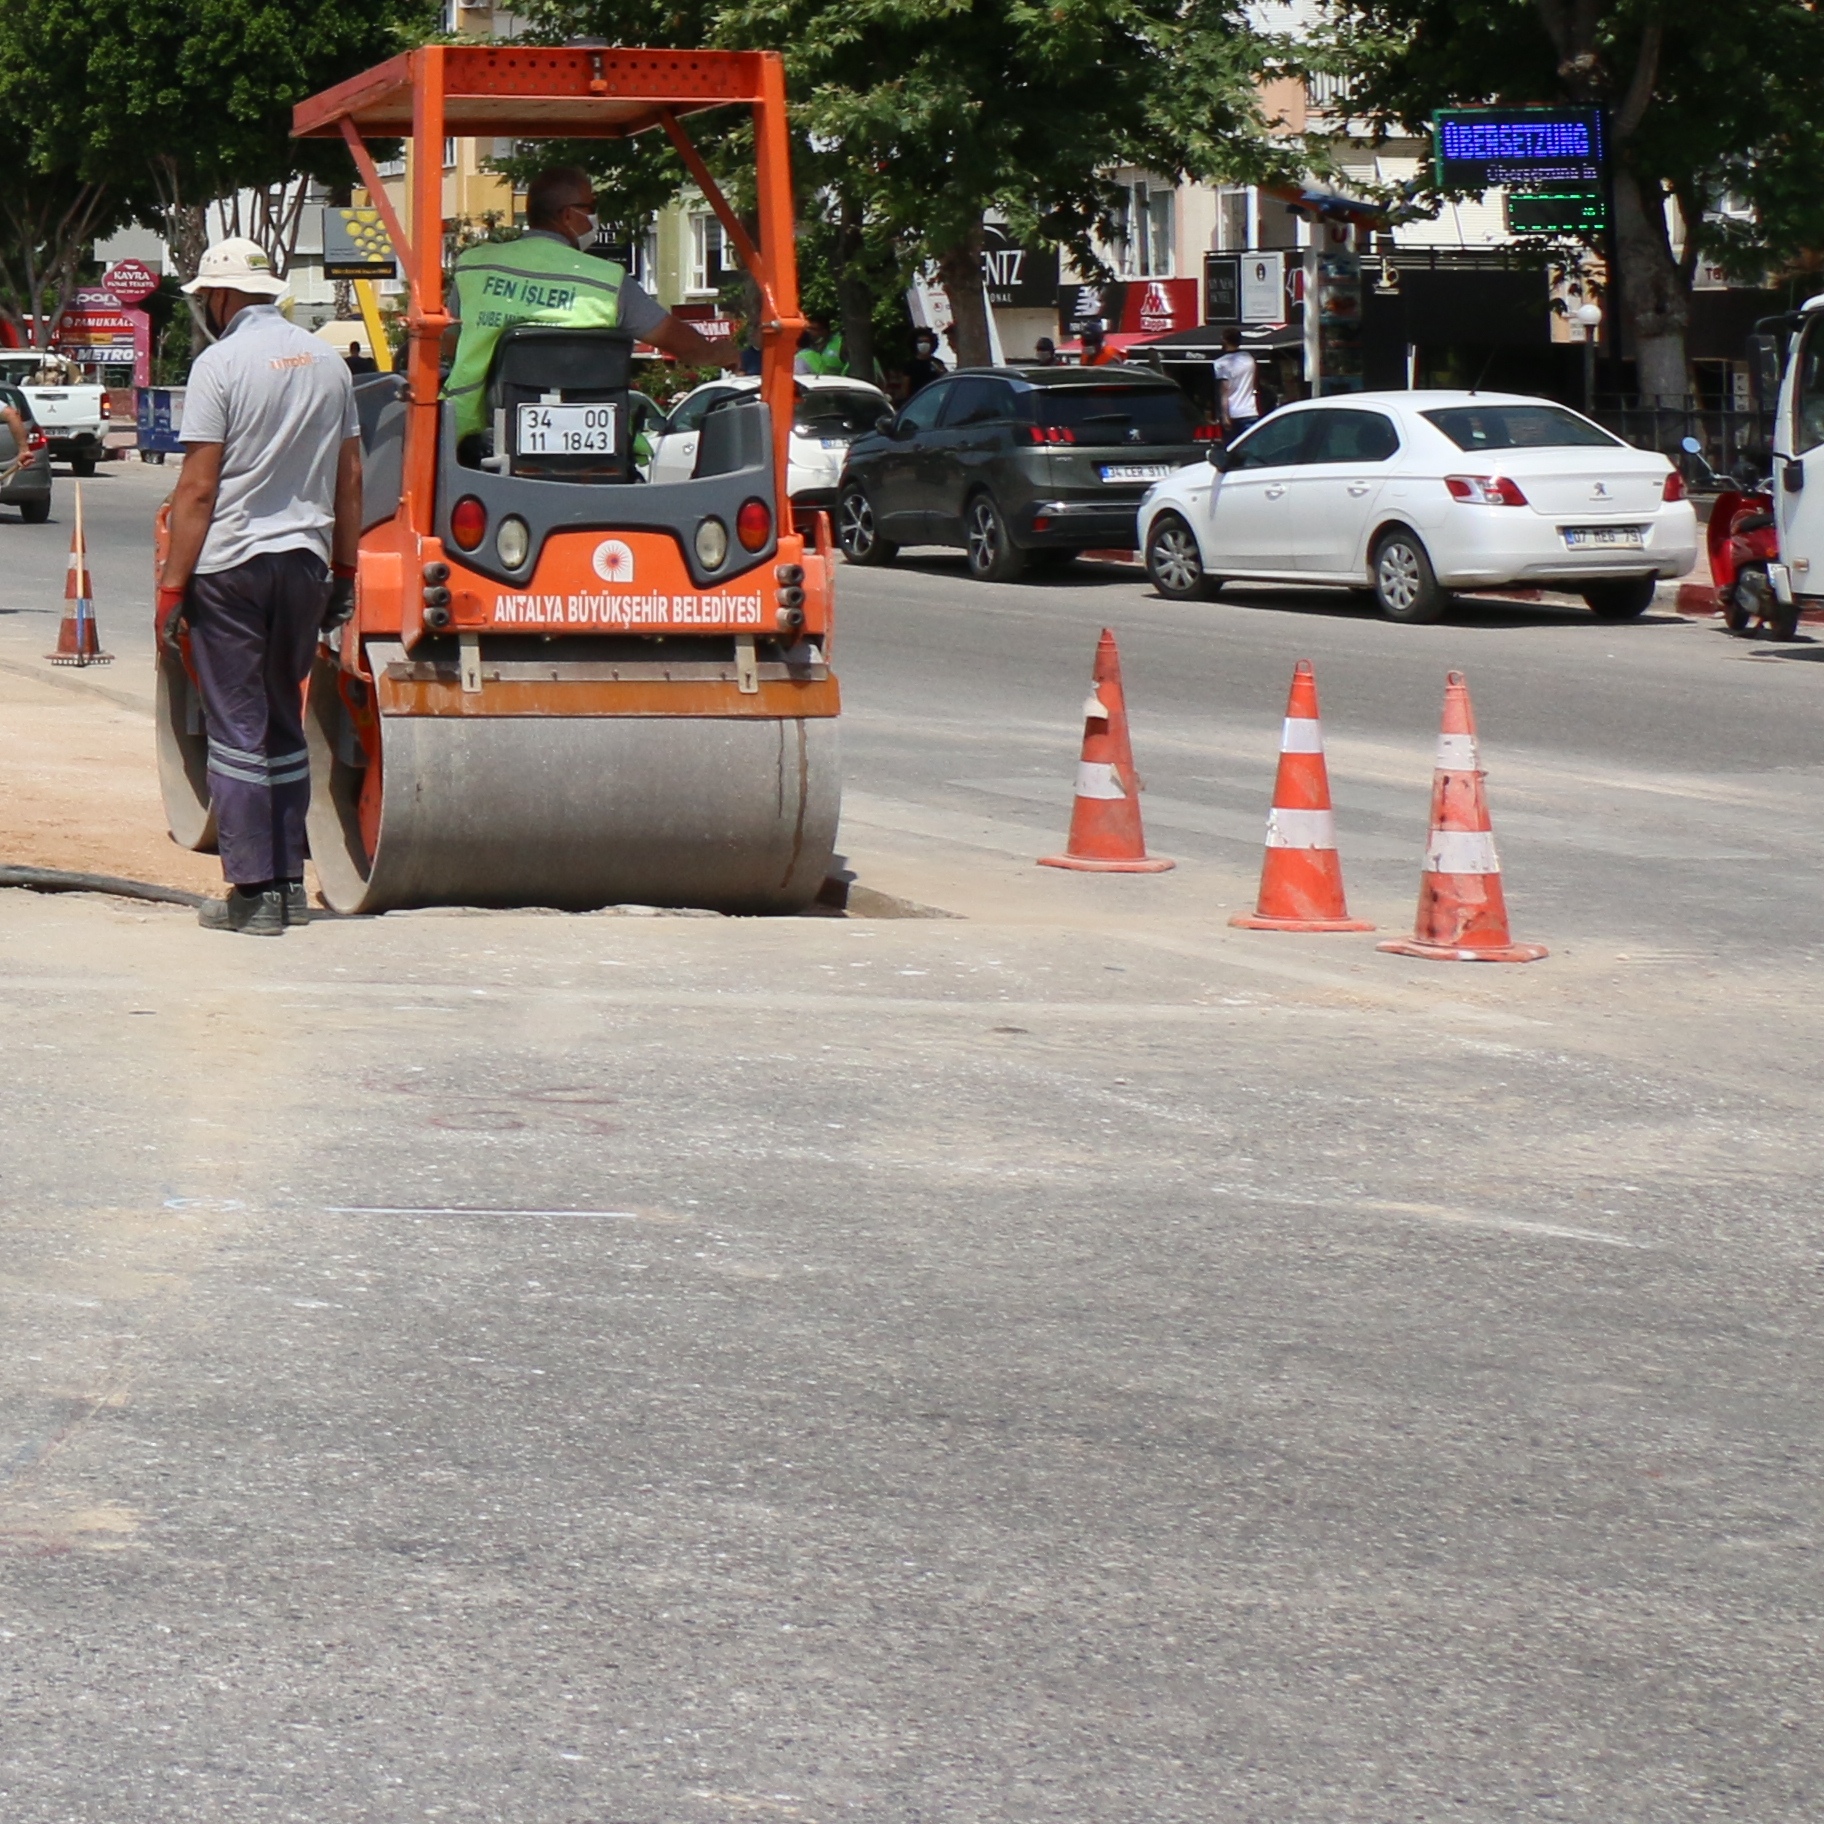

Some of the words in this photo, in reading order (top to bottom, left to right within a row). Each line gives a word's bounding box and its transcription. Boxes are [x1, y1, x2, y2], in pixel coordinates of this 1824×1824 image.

[113, 271, 150, 280] KAYRA
[483, 276, 517, 298] FEN
[520, 279, 576, 311] İŞLERİ
[77, 348, 135, 361] METRO
[527, 409, 552, 429] 34
[584, 409, 609, 428] 00
[530, 432, 546, 451] 11
[562, 431, 608, 451] 1843
[1572, 529, 1587, 543] 07
[494, 594, 564, 623] ANTALYA
[567, 589, 669, 630] BÜYÜKŞEHİR
[672, 589, 761, 624] BELEDİYESİ
